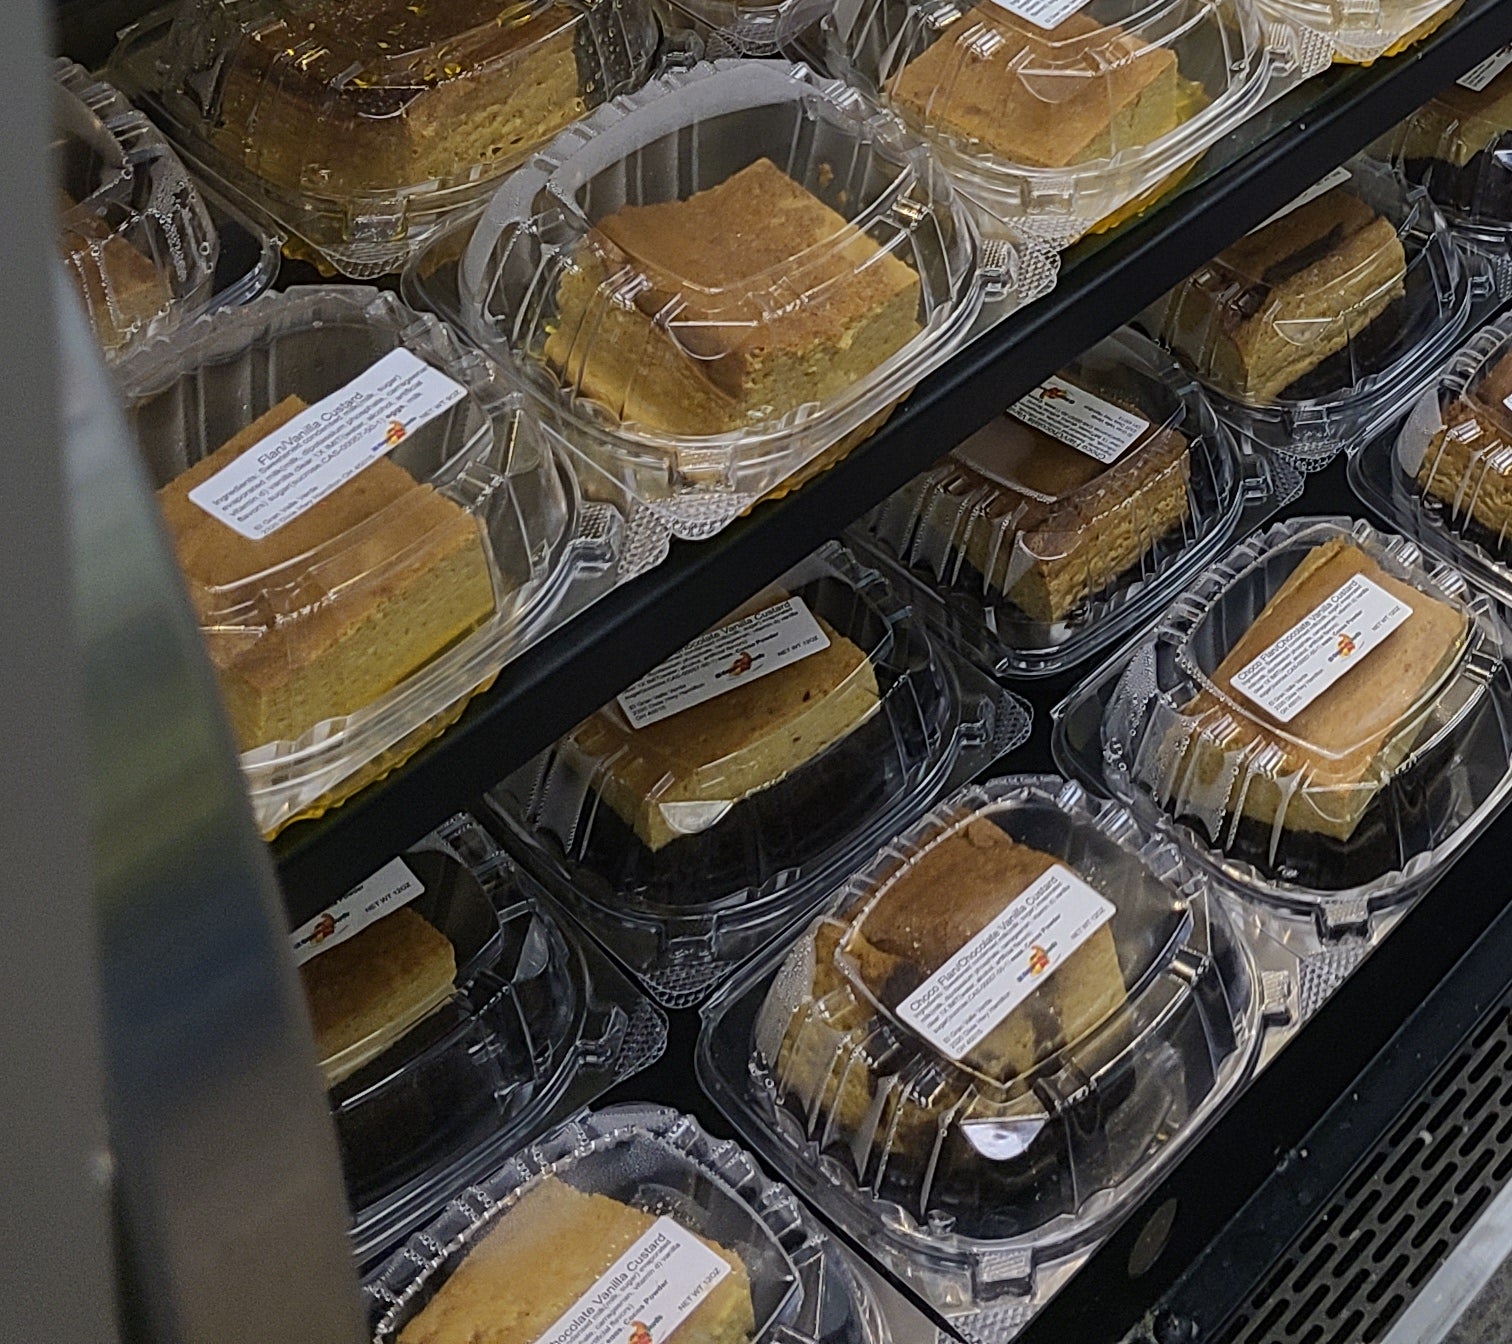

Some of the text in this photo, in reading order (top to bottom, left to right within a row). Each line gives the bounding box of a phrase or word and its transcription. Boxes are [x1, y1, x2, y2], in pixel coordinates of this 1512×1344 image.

[257, 391, 364, 466] Flan/Vanilla Custard
[753, 601, 791, 622] Custard
[1237, 659, 1263, 682] Choco
[1310, 602, 1333, 623] Vanilla
[1330, 579, 1358, 604] Custard
[909, 984, 940, 1012] Choco
[999, 906, 1028, 934] Vanilla
[1024, 875, 1059, 908] Custard
[591, 1272, 629, 1305] Vanilla
[626, 1231, 667, 1272] Custard
